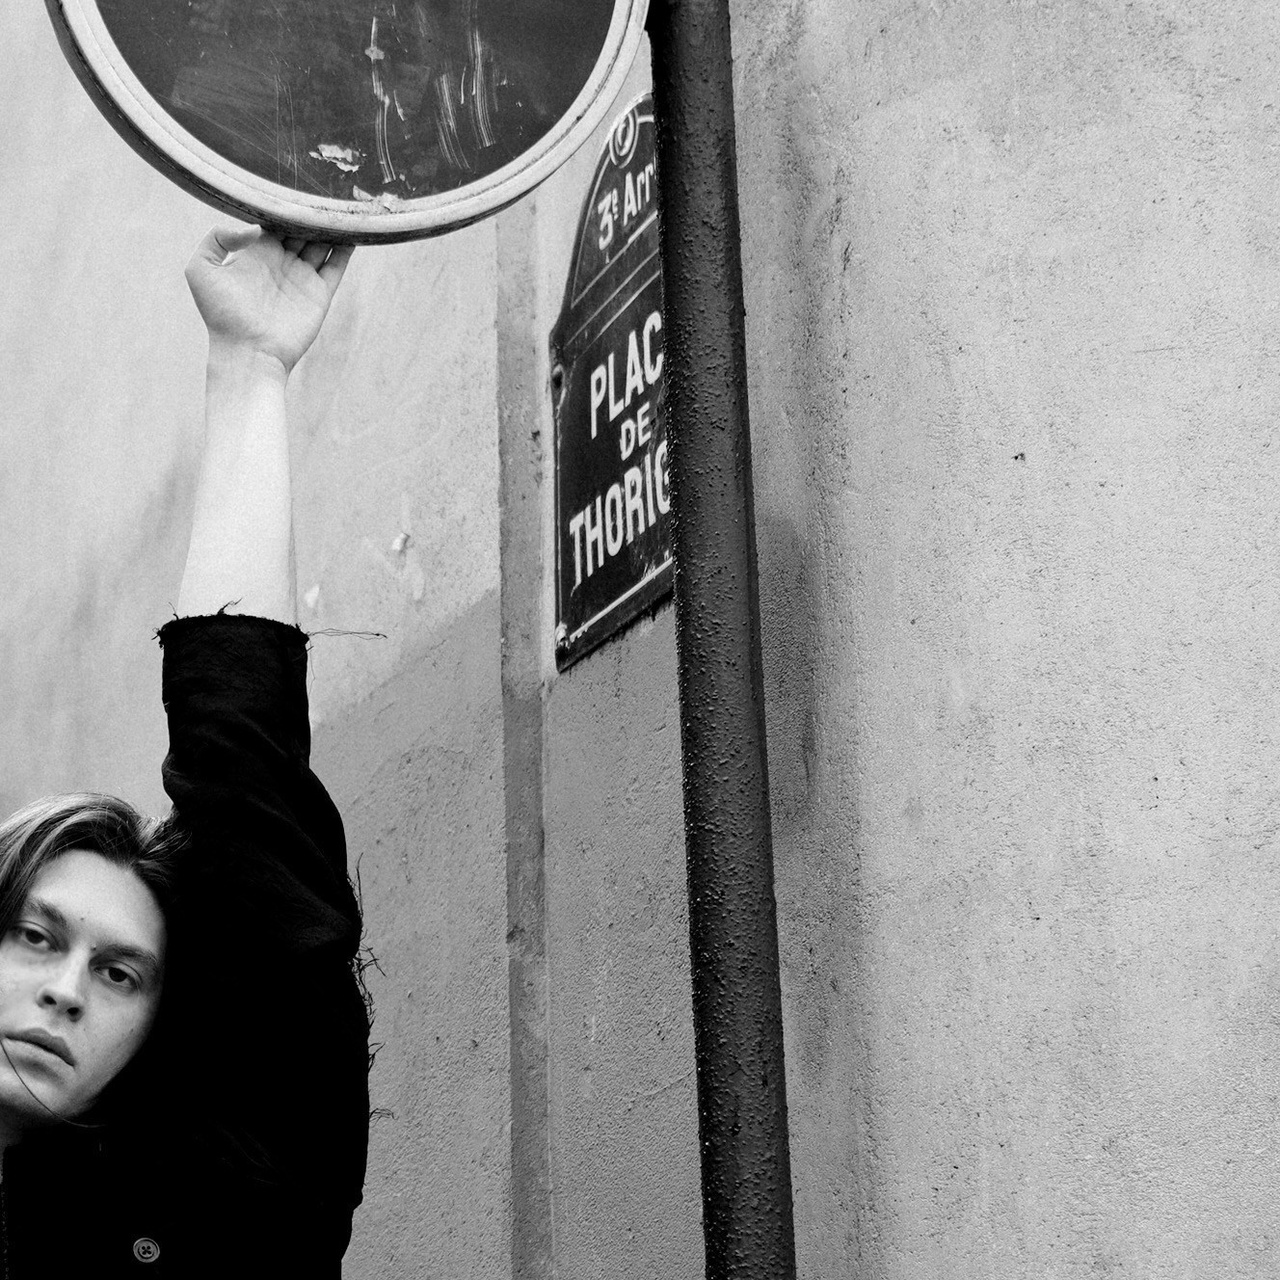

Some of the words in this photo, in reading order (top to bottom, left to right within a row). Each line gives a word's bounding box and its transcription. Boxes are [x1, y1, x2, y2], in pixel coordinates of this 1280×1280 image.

[624, 151, 657, 226] Arr
[590, 310, 664, 440] PLAC
[620, 401, 651, 461] DE
